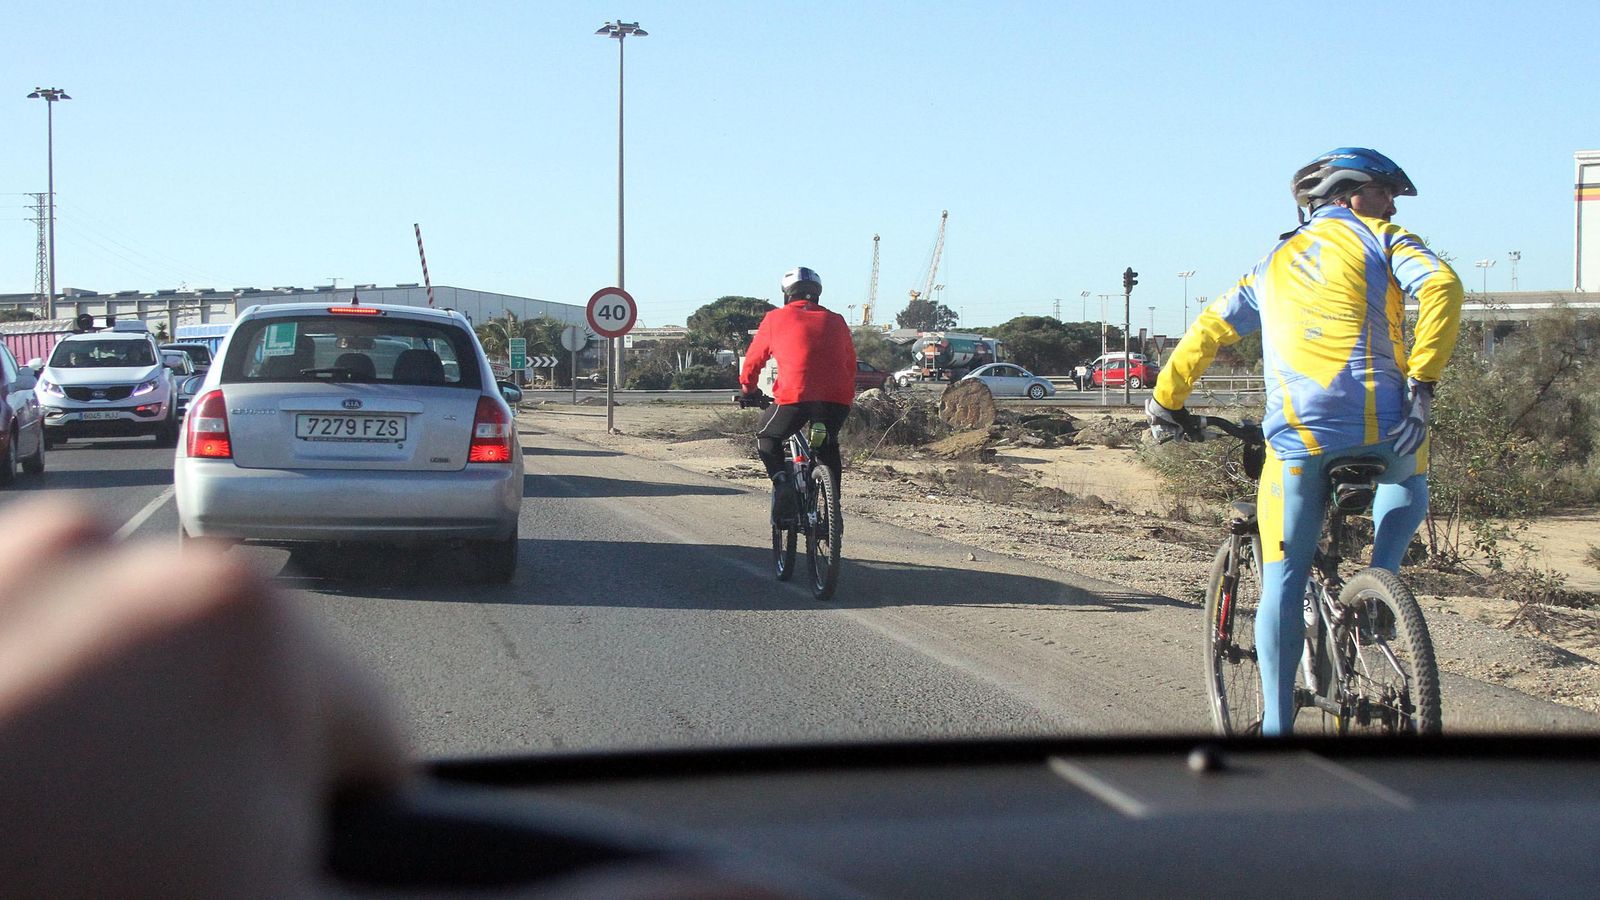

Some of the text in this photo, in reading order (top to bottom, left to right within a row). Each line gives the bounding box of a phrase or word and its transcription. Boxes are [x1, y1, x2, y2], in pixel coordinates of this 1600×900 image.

[598, 305, 625, 320] 40
[268, 326, 291, 347] L
[308, 418, 399, 436] 7279 FZS
